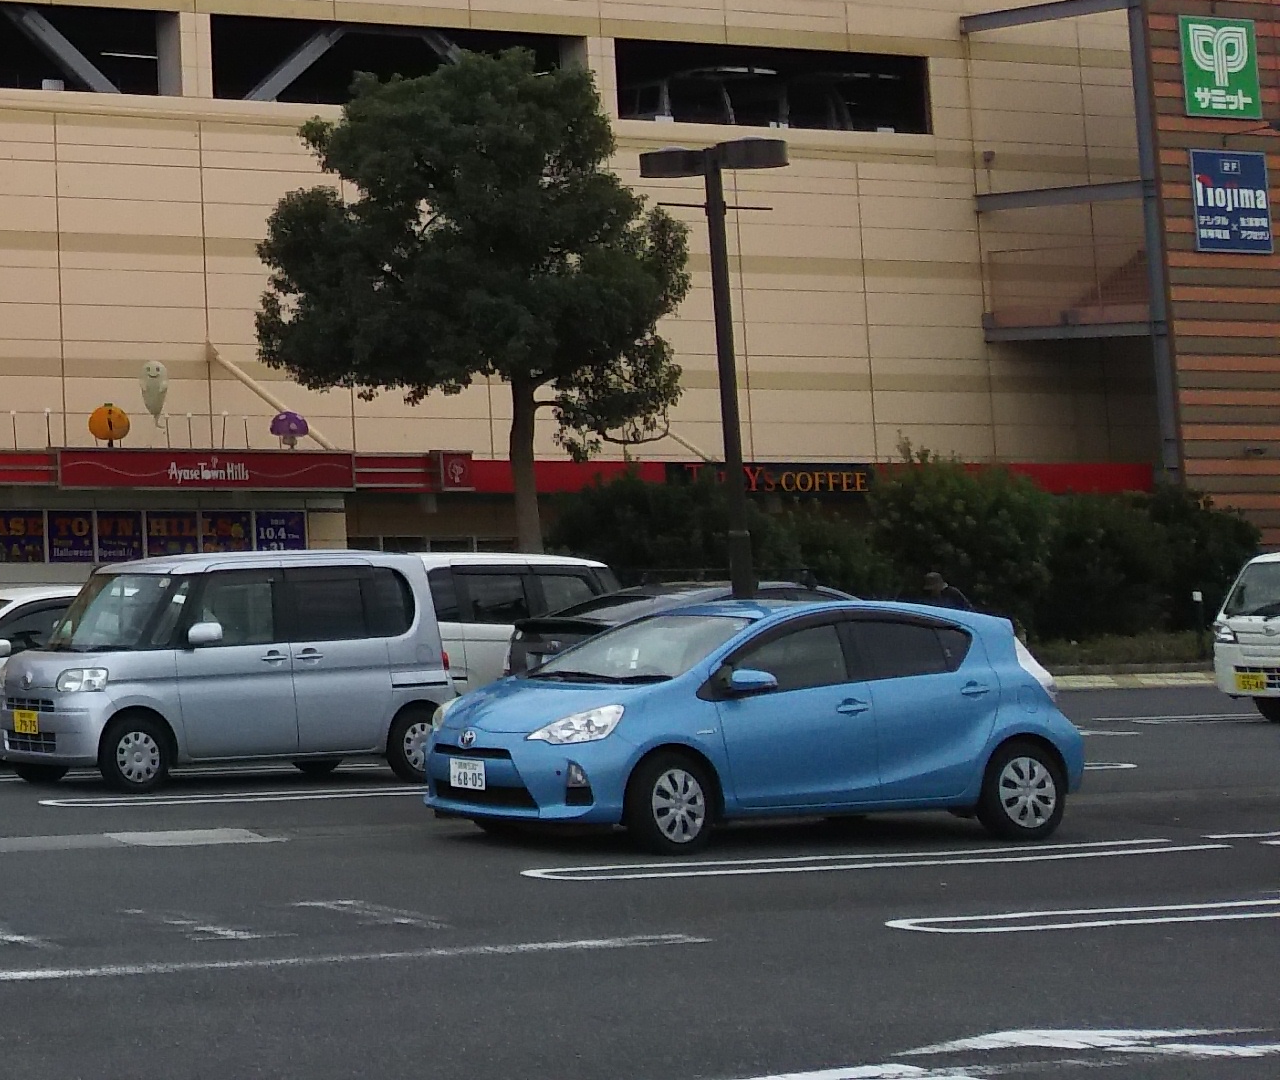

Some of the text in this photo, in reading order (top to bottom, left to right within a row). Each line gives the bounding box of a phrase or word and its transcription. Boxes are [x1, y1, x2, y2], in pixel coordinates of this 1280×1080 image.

[1194, 86, 1253, 111] サミット
[168, 461, 200, 484] Ayase
[227, 462, 250, 480] Hills
[780, 471, 869, 492] COFFEE
[259, 527, 286, 539] 10.4
